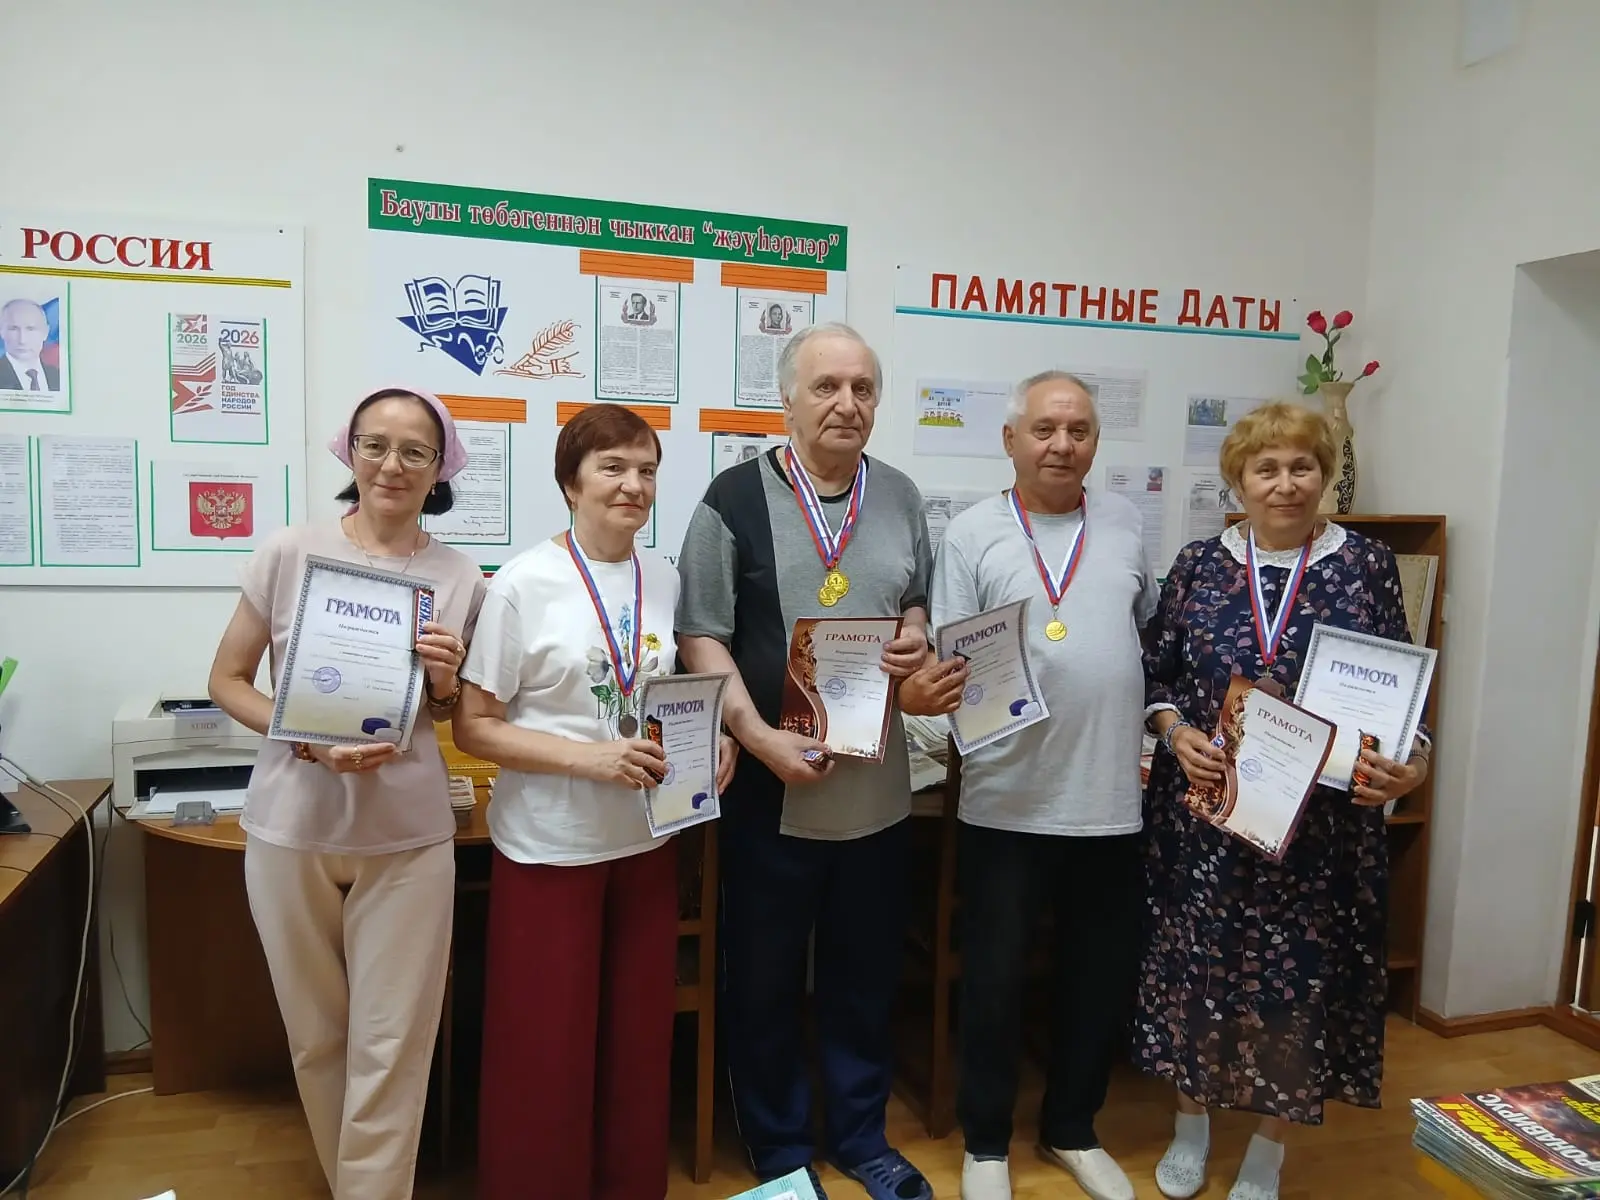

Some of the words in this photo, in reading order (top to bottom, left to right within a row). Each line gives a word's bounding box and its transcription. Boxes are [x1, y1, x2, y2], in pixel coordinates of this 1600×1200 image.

[380, 189, 461, 226] Баулы
[468, 200, 602, 236] төбәгеннән
[609, 218, 694, 244] чыккан
[20, 228, 213, 271] РОССИЯ
[931, 273, 1159, 323] ПАМЯТНЫЕ
[1177, 289, 1281, 331] ДАТЫ
[177, 333, 208, 345] 2026
[220, 328, 259, 345] 2026
[325, 598, 402, 625] ГРАМОТА
[417, 593, 432, 640] NKERS
[825, 633, 882, 643] ГРАМОТА
[954, 621, 1008, 651] ГРАМОТА
[1330, 660, 1399, 688] ГРАМОТА
[656, 699, 705, 718] ГРАМОТА
[1257, 707, 1313, 743] ГРАМОТА
